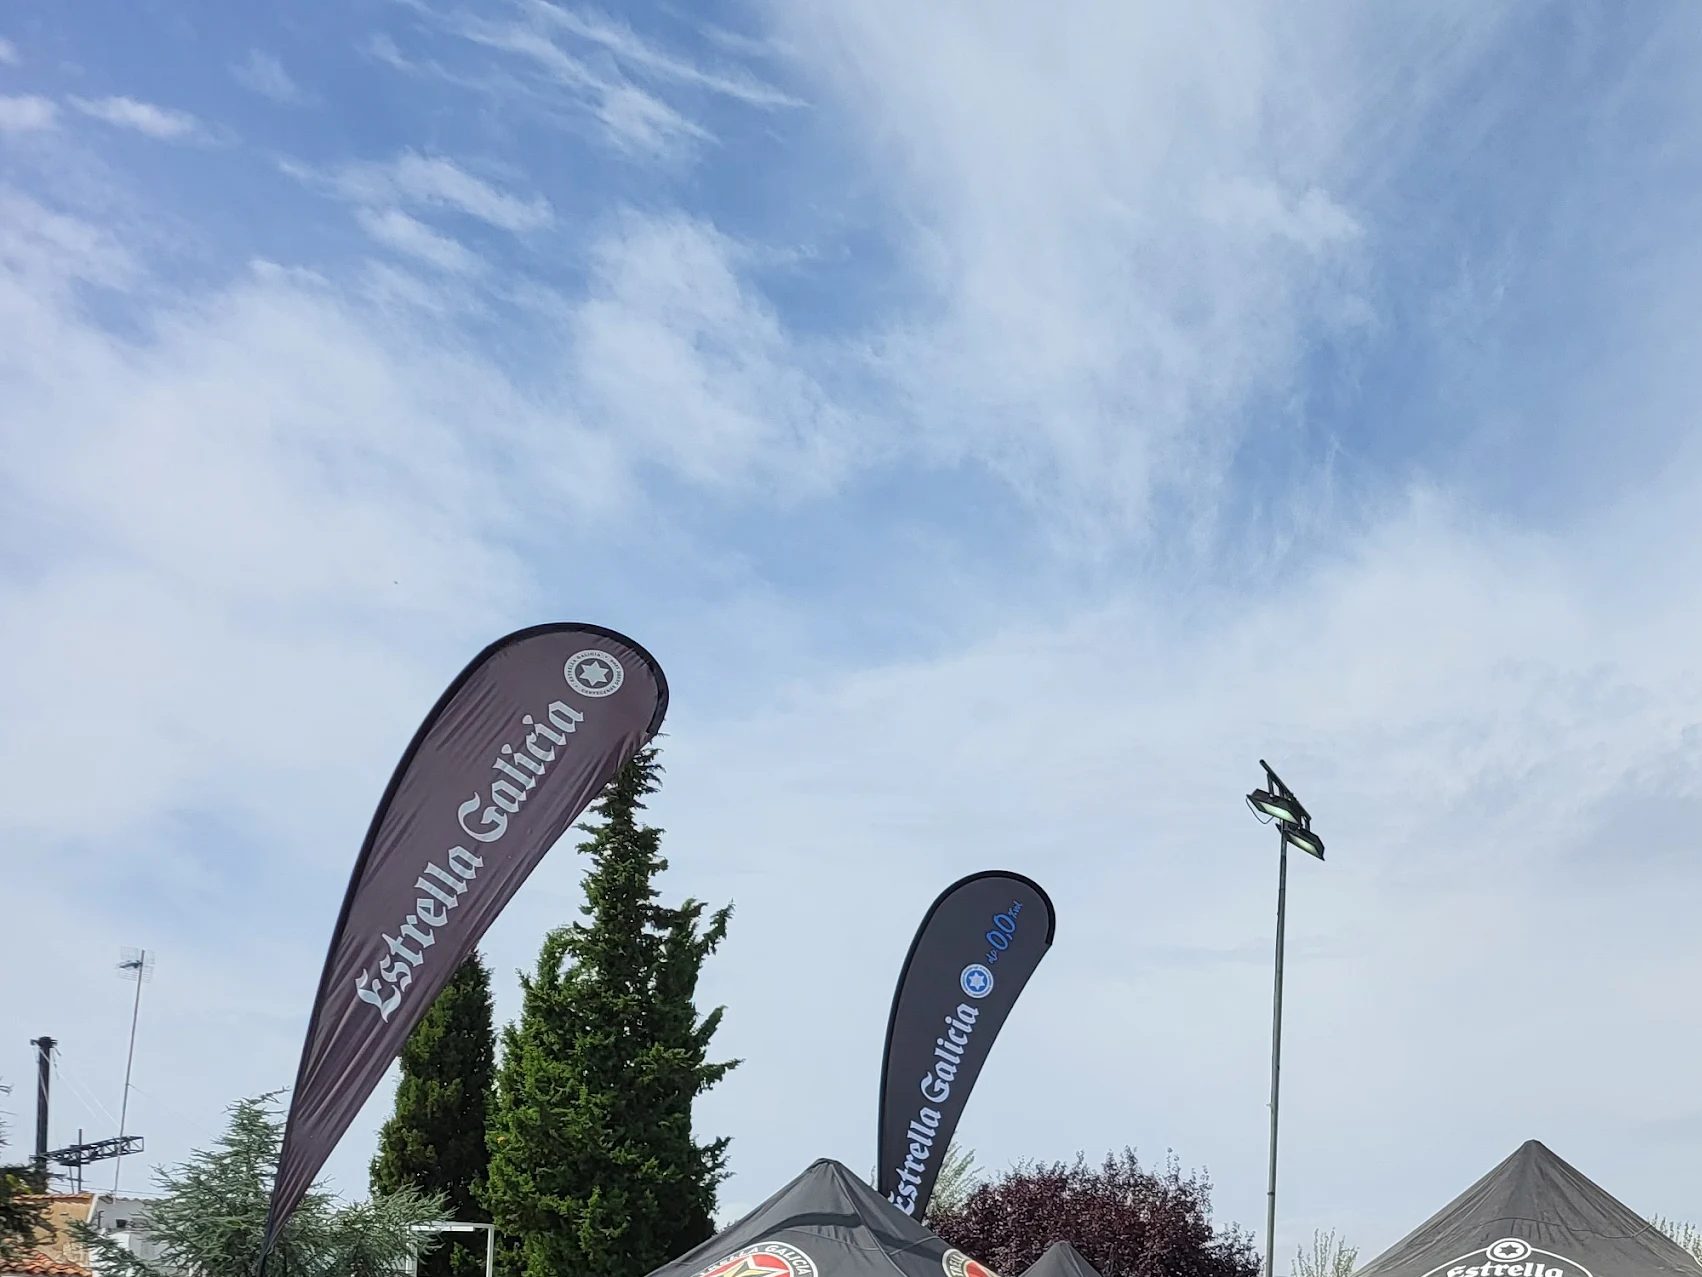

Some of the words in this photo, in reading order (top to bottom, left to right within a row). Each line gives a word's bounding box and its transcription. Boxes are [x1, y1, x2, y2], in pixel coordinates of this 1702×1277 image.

[355, 845, 484, 1023] Estrella
[458, 699, 585, 843] Galicia
[985, 913, 1016, 950] 0,0
[888, 1107, 942, 1216] Estrella
[921, 1003, 980, 1103] Galicia
[765, 1244, 812, 1277] GALICIA
